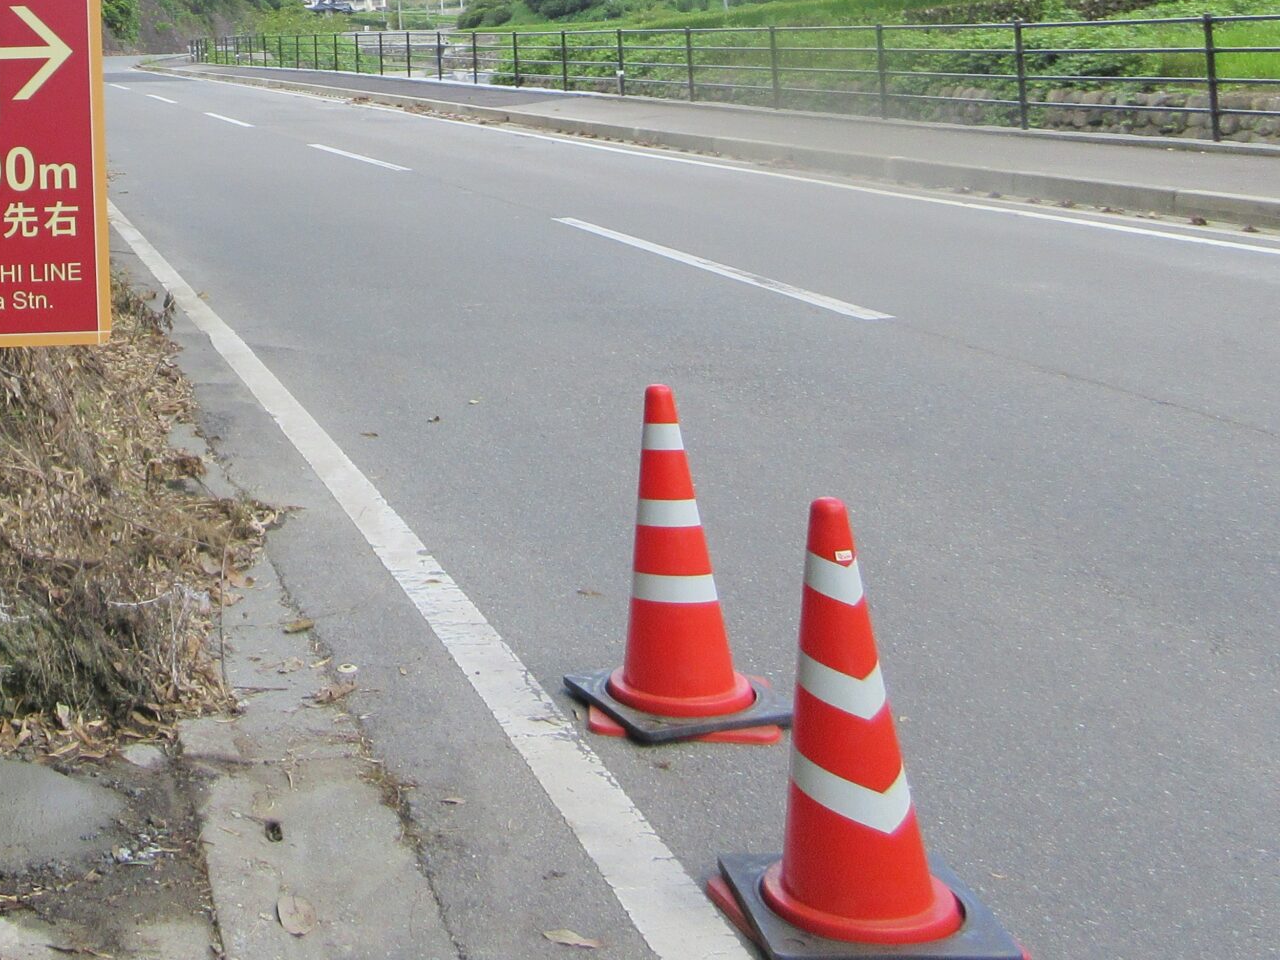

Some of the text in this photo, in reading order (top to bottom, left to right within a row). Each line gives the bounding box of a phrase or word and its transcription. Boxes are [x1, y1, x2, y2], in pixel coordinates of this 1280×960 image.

[3, 201, 79, 238] 先右
[30, 262, 82, 282] LINE
[12, 290, 54, 310] Stn.
